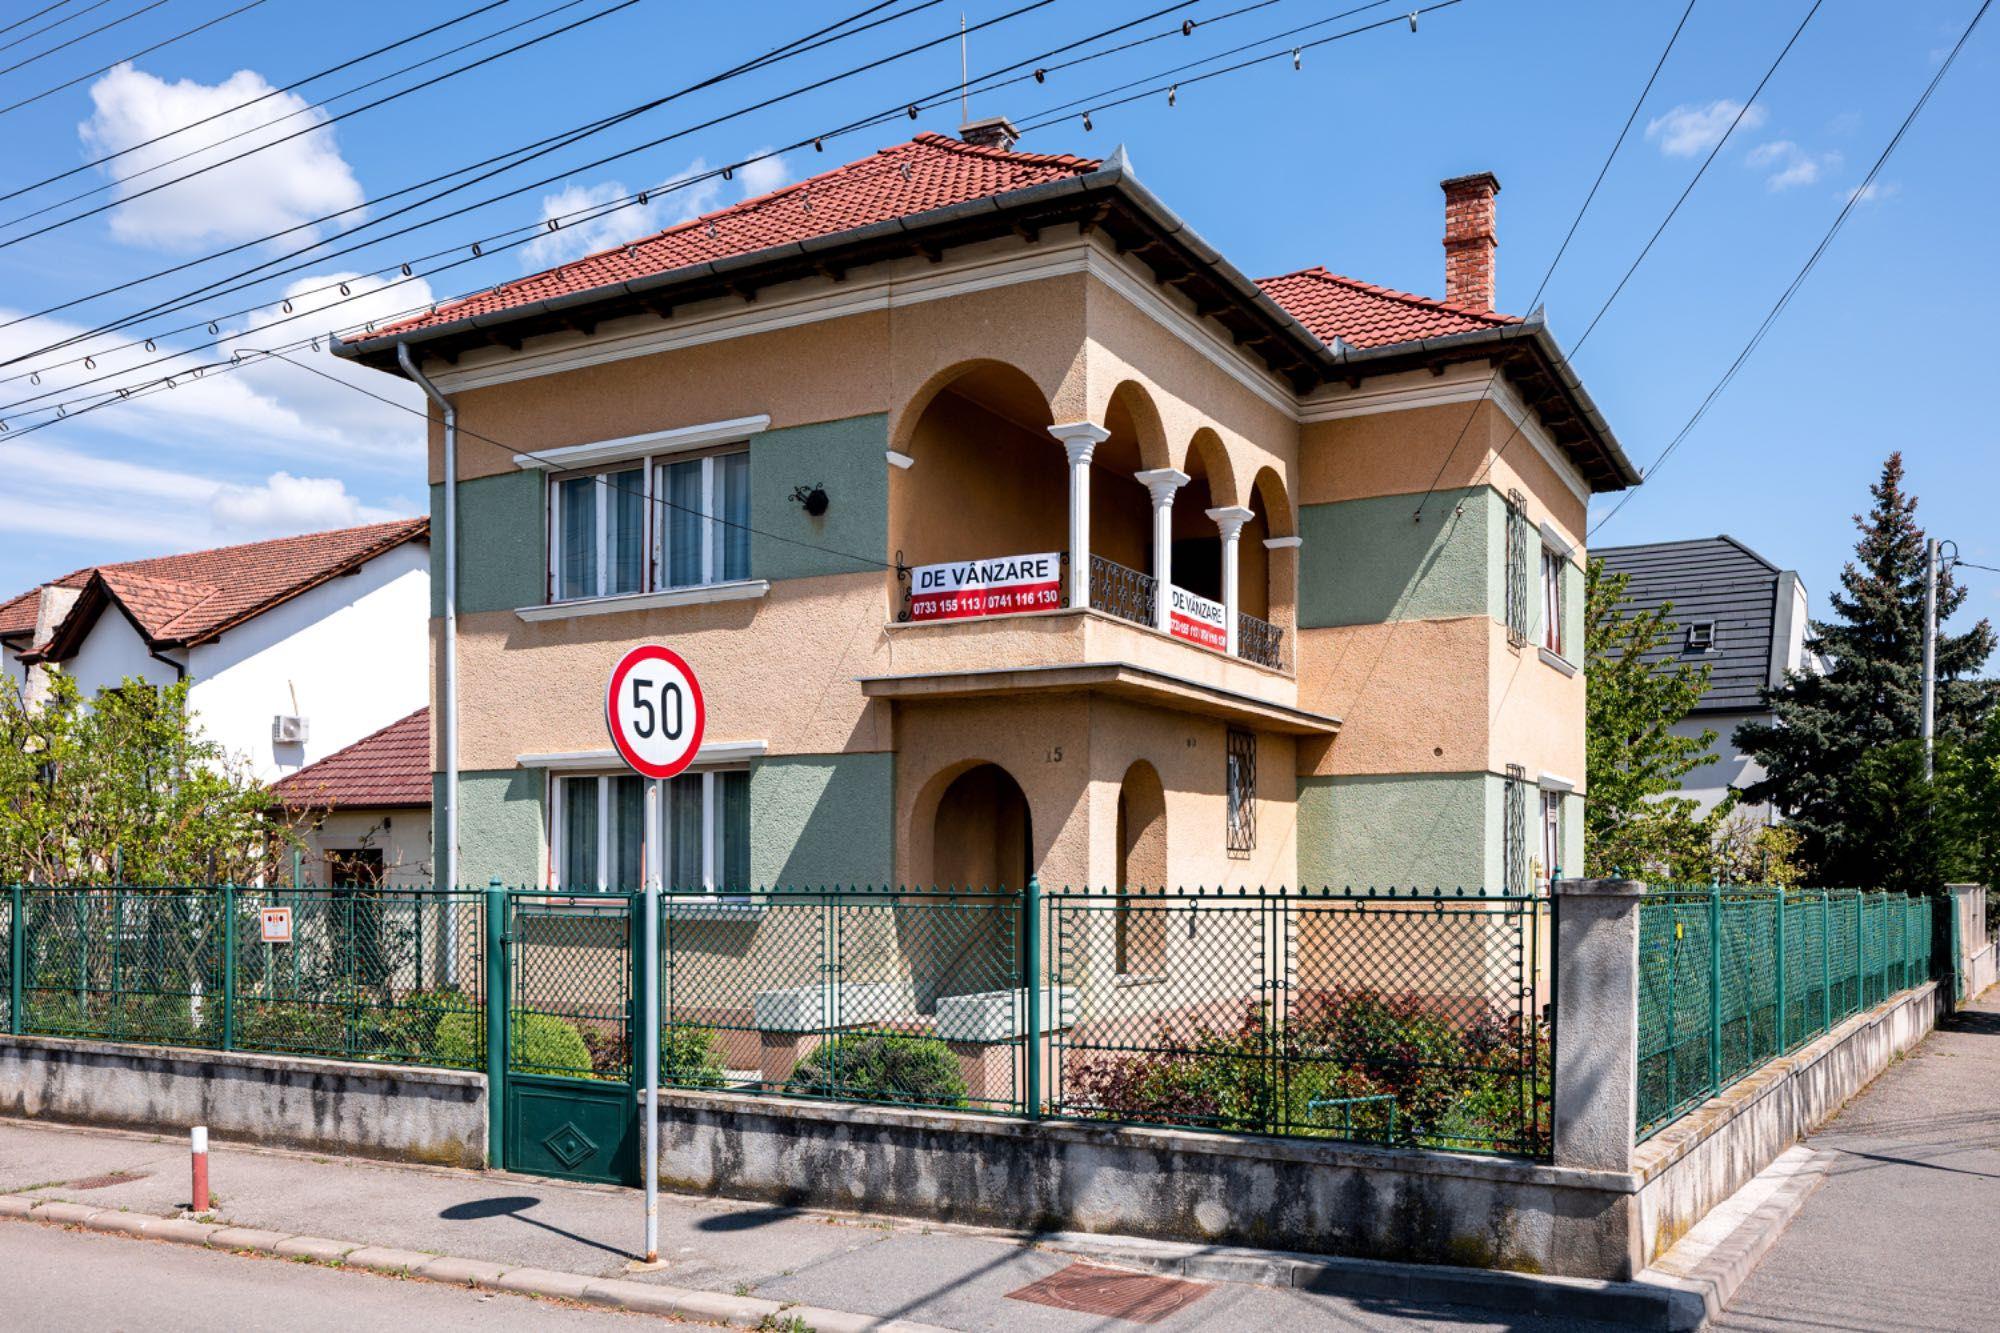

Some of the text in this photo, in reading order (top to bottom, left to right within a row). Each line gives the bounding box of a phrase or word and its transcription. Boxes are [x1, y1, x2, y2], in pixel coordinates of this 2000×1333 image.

[921, 559, 1049, 588] DE VÂNZARE
[913, 601, 937, 615] 0733
[940, 599, 958, 612] 155
[961, 597, 980, 611] 113
[1015, 592, 1035, 606] 116
[1037, 590, 1058, 604] 130
[1172, 591, 1185, 610] DE
[632, 678, 683, 741] 50
